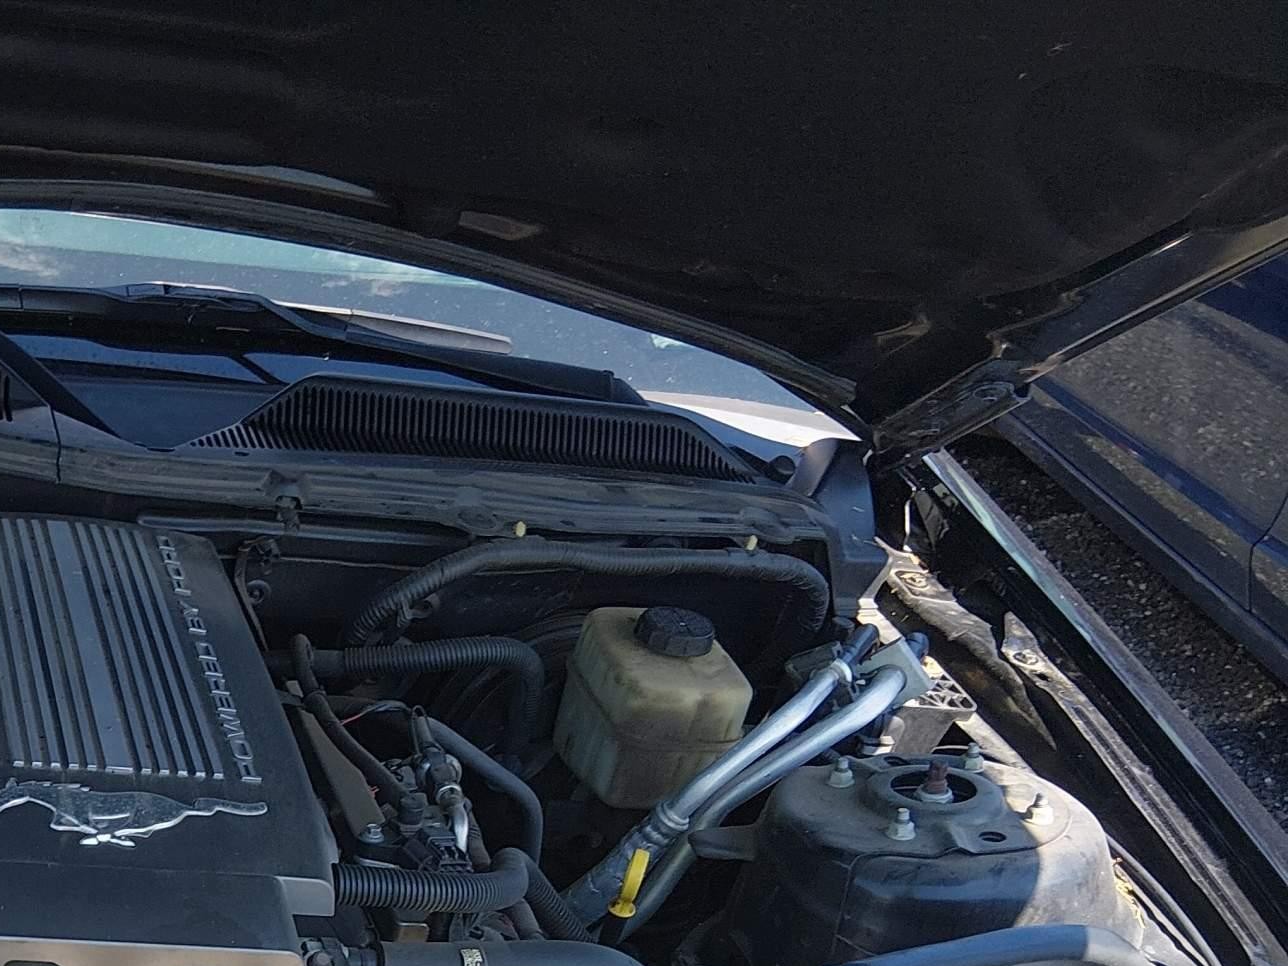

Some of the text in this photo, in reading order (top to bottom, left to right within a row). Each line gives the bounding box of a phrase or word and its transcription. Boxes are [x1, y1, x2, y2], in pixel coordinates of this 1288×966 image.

[156, 535, 263, 783] POWERED BY FORD
